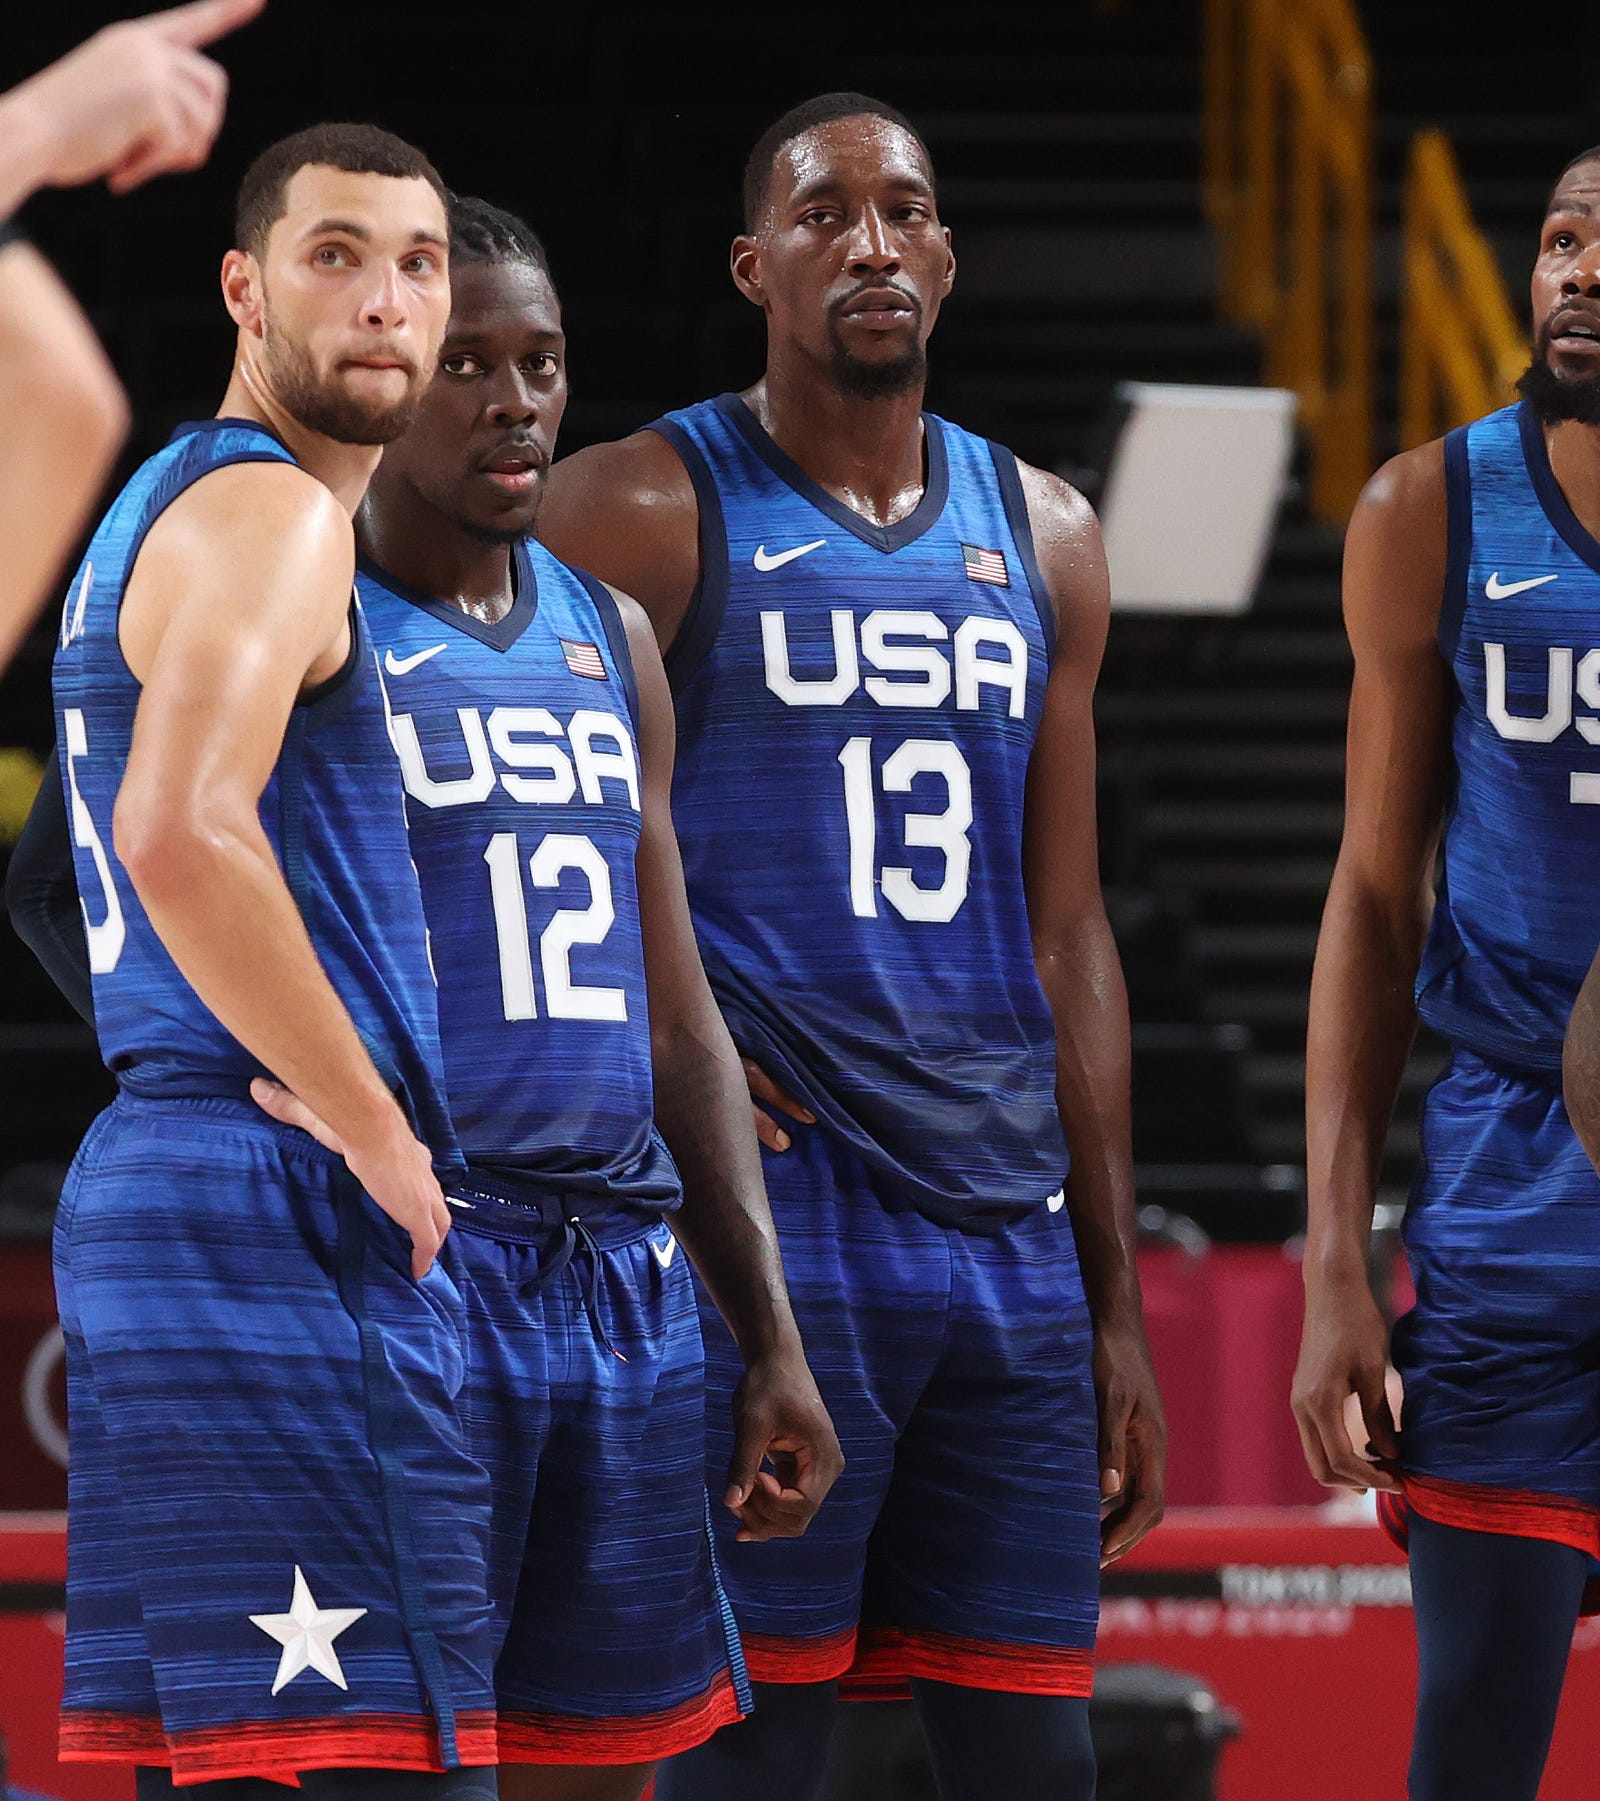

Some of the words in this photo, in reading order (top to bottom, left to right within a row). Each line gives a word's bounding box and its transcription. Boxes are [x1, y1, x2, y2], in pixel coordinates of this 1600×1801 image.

[760, 610, 1028, 718] USA
[391, 707, 640, 812] USA
[838, 737, 973, 923] 13
[483, 832, 628, 1022] 12
